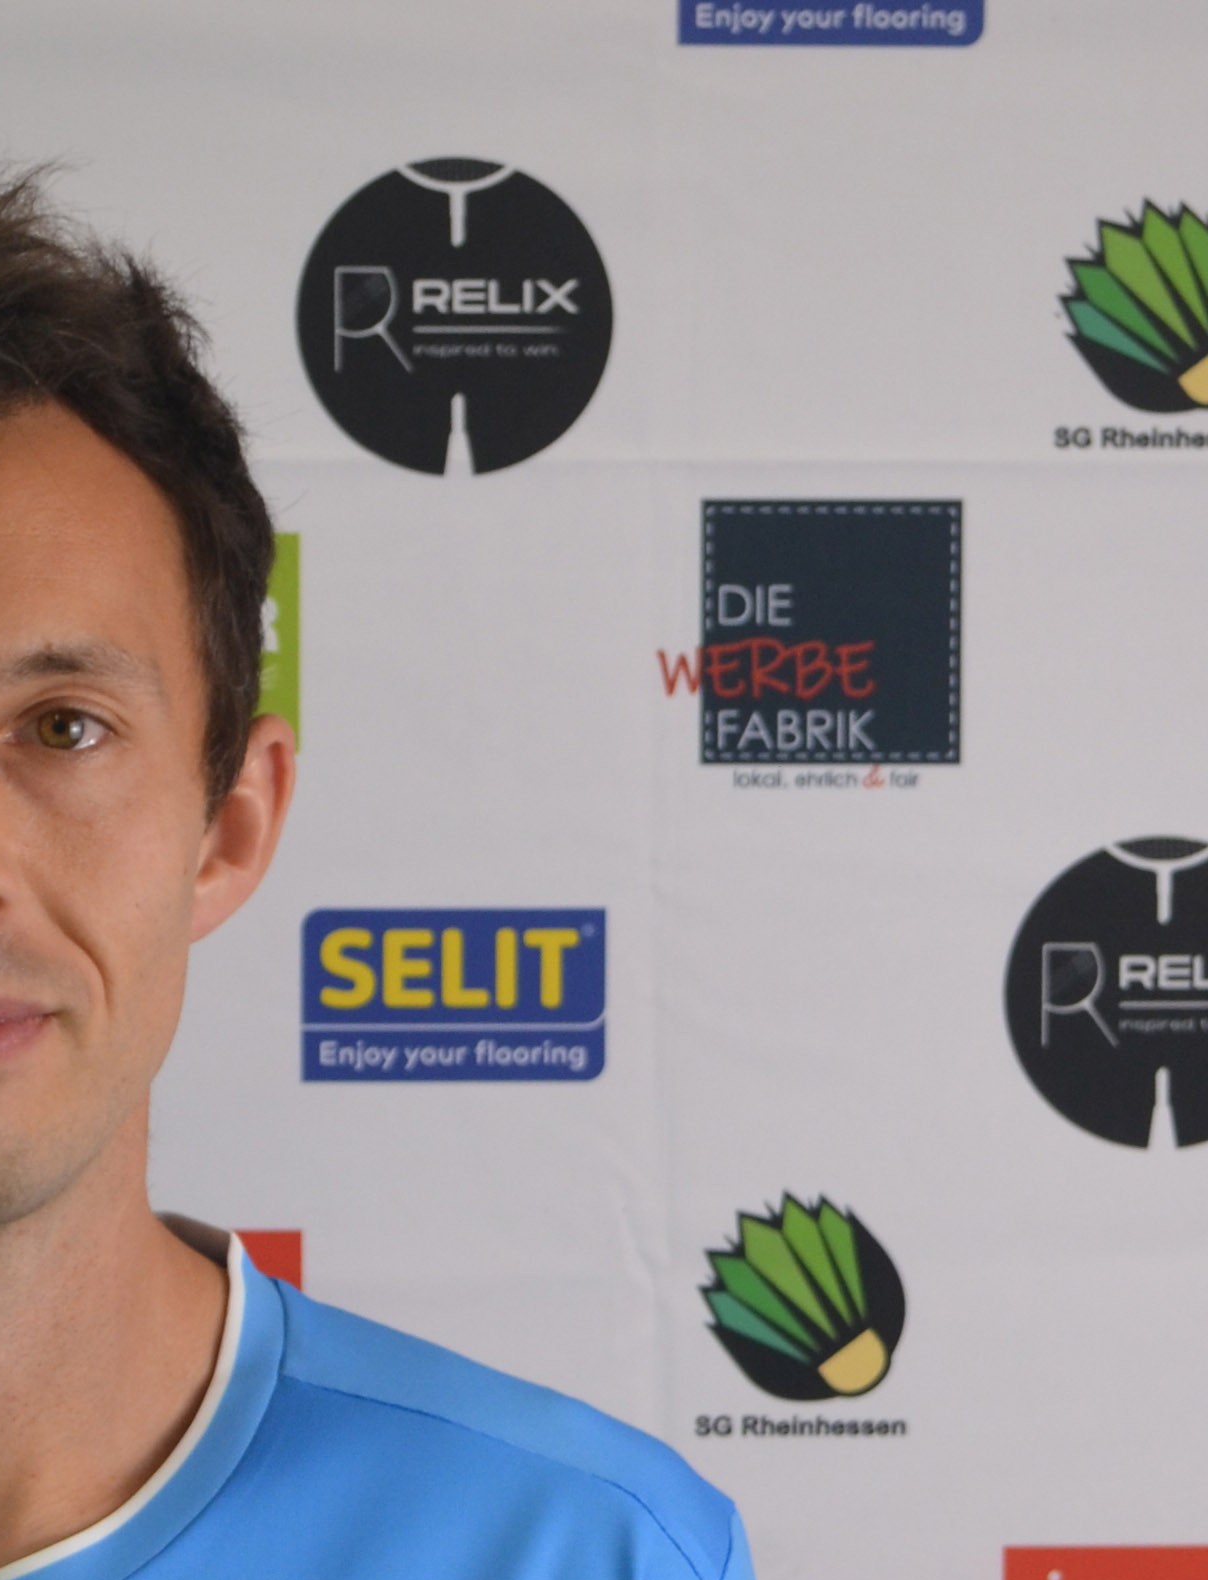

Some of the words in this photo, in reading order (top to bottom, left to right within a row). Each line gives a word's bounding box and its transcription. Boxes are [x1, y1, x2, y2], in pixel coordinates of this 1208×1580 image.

[695, 2, 772, 34] Enjoy
[780, 8, 843, 34] your
[852, 2, 966, 36] flooring
[412, 278, 579, 315] RELIX
[1053, 425, 1092, 449] SG
[1100, 425, 1208, 449] Rheinhe
[717, 583, 794, 626] DIE
[656, 637, 878, 699] WERBE
[717, 709, 877, 751] FABRIK
[319, 927, 581, 1010] SELIT
[318, 1040, 397, 1071] Enjoy
[404, 1045, 468, 1071] your
[474, 1040, 589, 1072] flooring
[695, 1414, 732, 1437] SG
[741, 1414, 907, 1437] Rheinhessen
